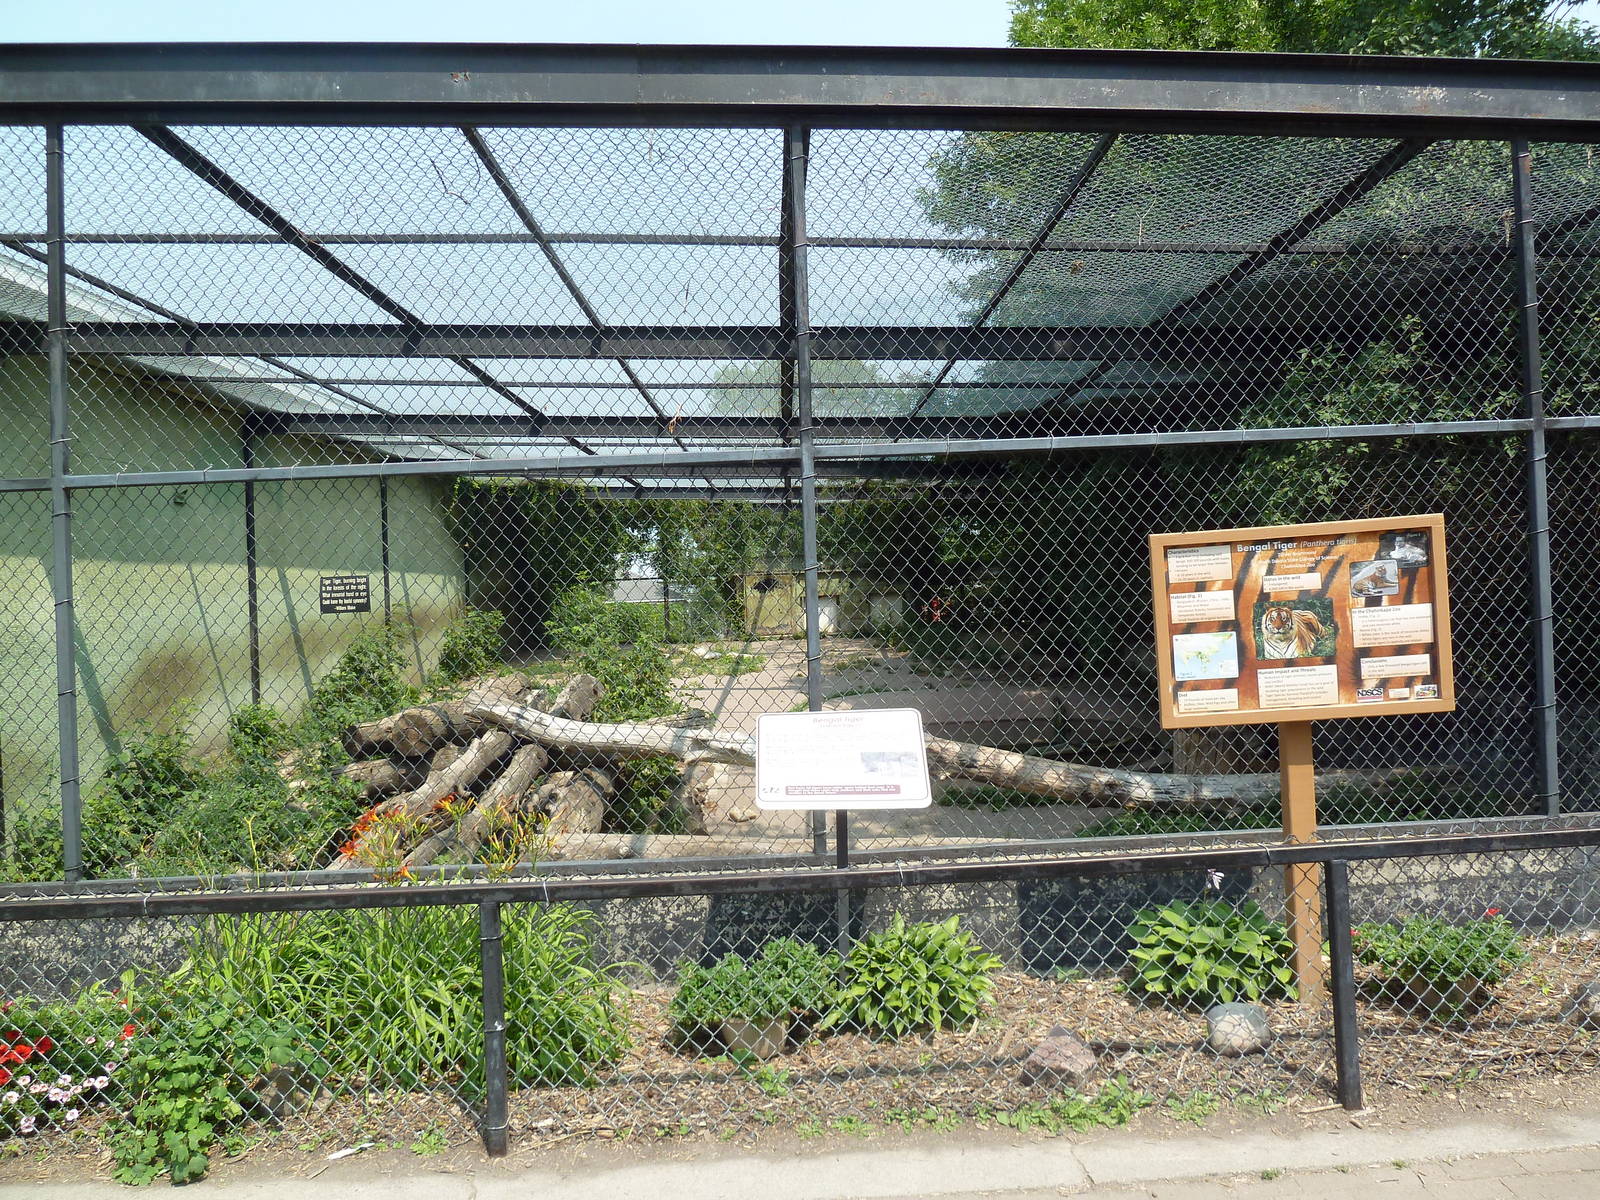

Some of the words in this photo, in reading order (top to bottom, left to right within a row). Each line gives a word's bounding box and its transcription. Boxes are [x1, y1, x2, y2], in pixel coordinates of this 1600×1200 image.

[1236, 541, 1271, 553] Bengal
[1272, 540, 1298, 551] Tiger
[1300, 539, 1335, 549] (Panthera
[1336, 536, 1357, 545] tigris)
[1357, 688, 1383, 697] NDSCS
